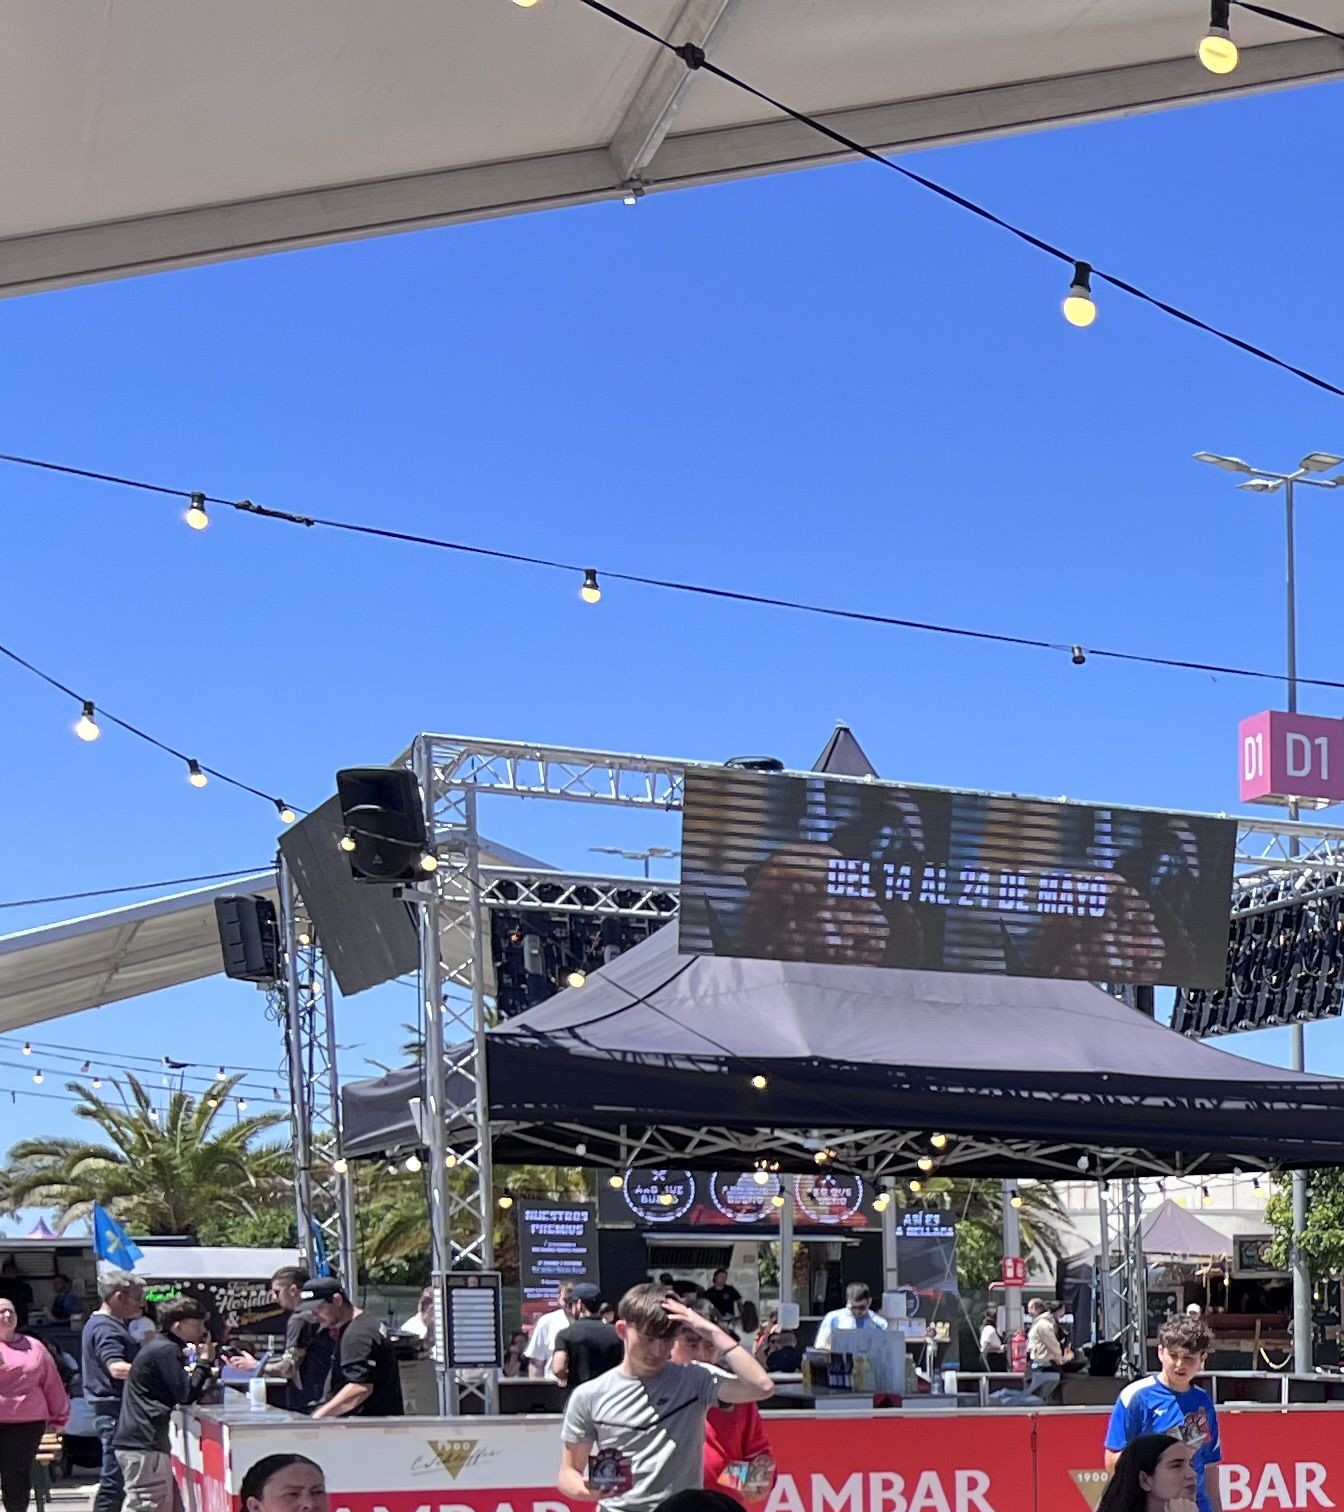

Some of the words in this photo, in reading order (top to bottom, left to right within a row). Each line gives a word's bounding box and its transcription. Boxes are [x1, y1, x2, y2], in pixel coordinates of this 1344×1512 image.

[1244, 732, 1264, 781] D1
[1286, 732, 1328, 780] D1
[827, 858, 876, 897] DEL
[883, 862, 912, 900] 14
[920, 862, 950, 905] AL
[999, 868, 1029, 912] DE
[1037, 870, 1108, 917] MAYO
[1077, 1472, 1109, 1483] 1900
[1218, 1462, 1336, 1511] BAR
